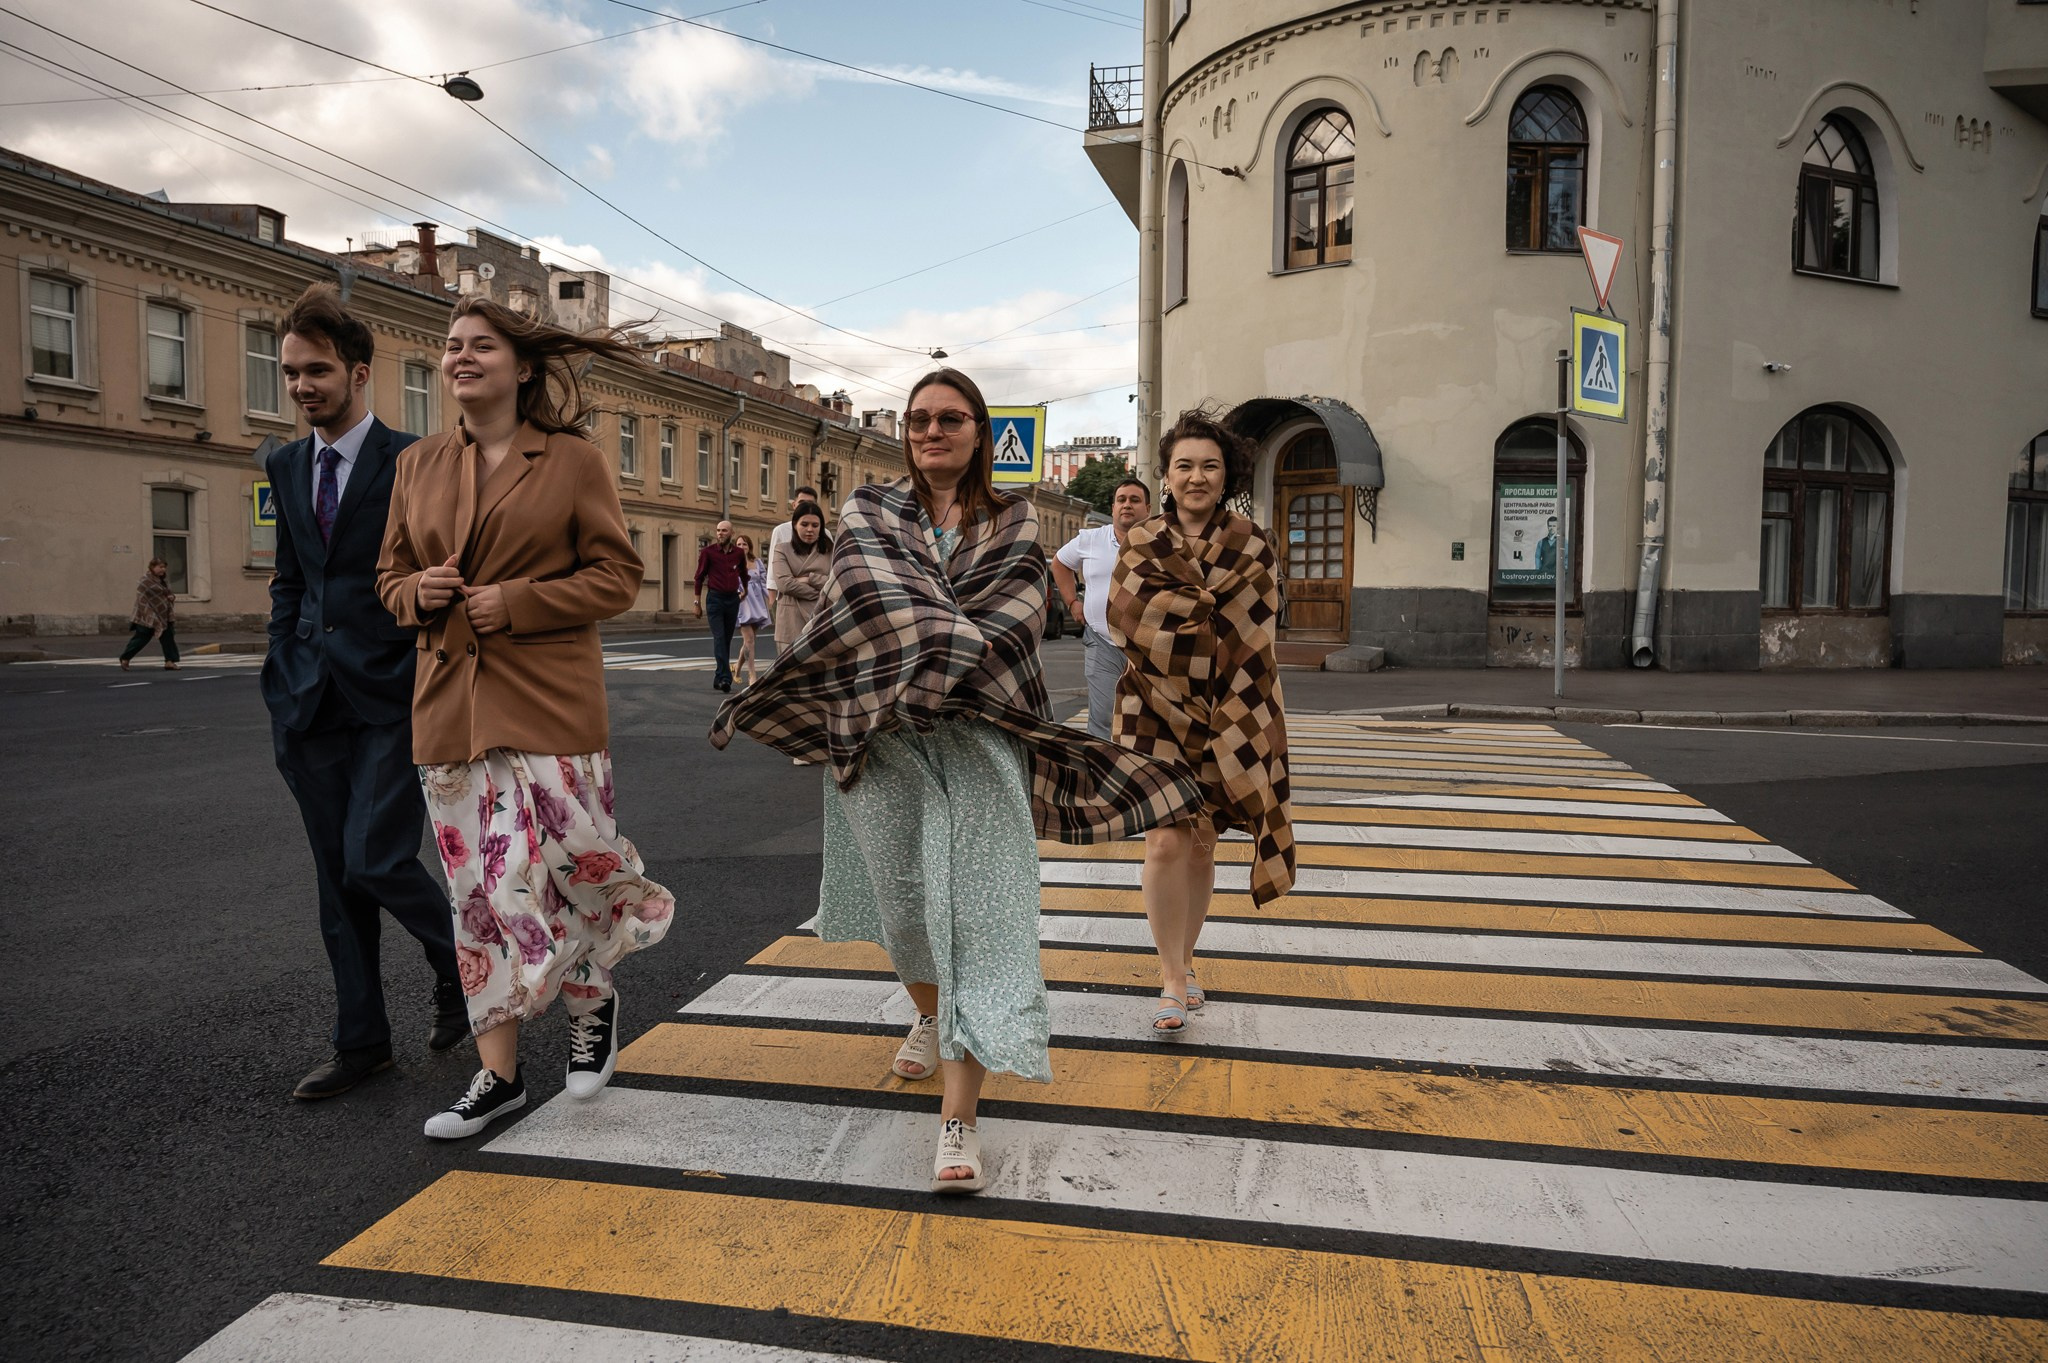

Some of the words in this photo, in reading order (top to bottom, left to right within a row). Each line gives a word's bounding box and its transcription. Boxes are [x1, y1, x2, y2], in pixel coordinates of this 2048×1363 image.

[1504, 488, 1535, 496] ЯРОСЛАВ
[1536, 488, 1558, 496] КОСТР
[1501, 572, 1556, 581] kostrovyaroslav.
